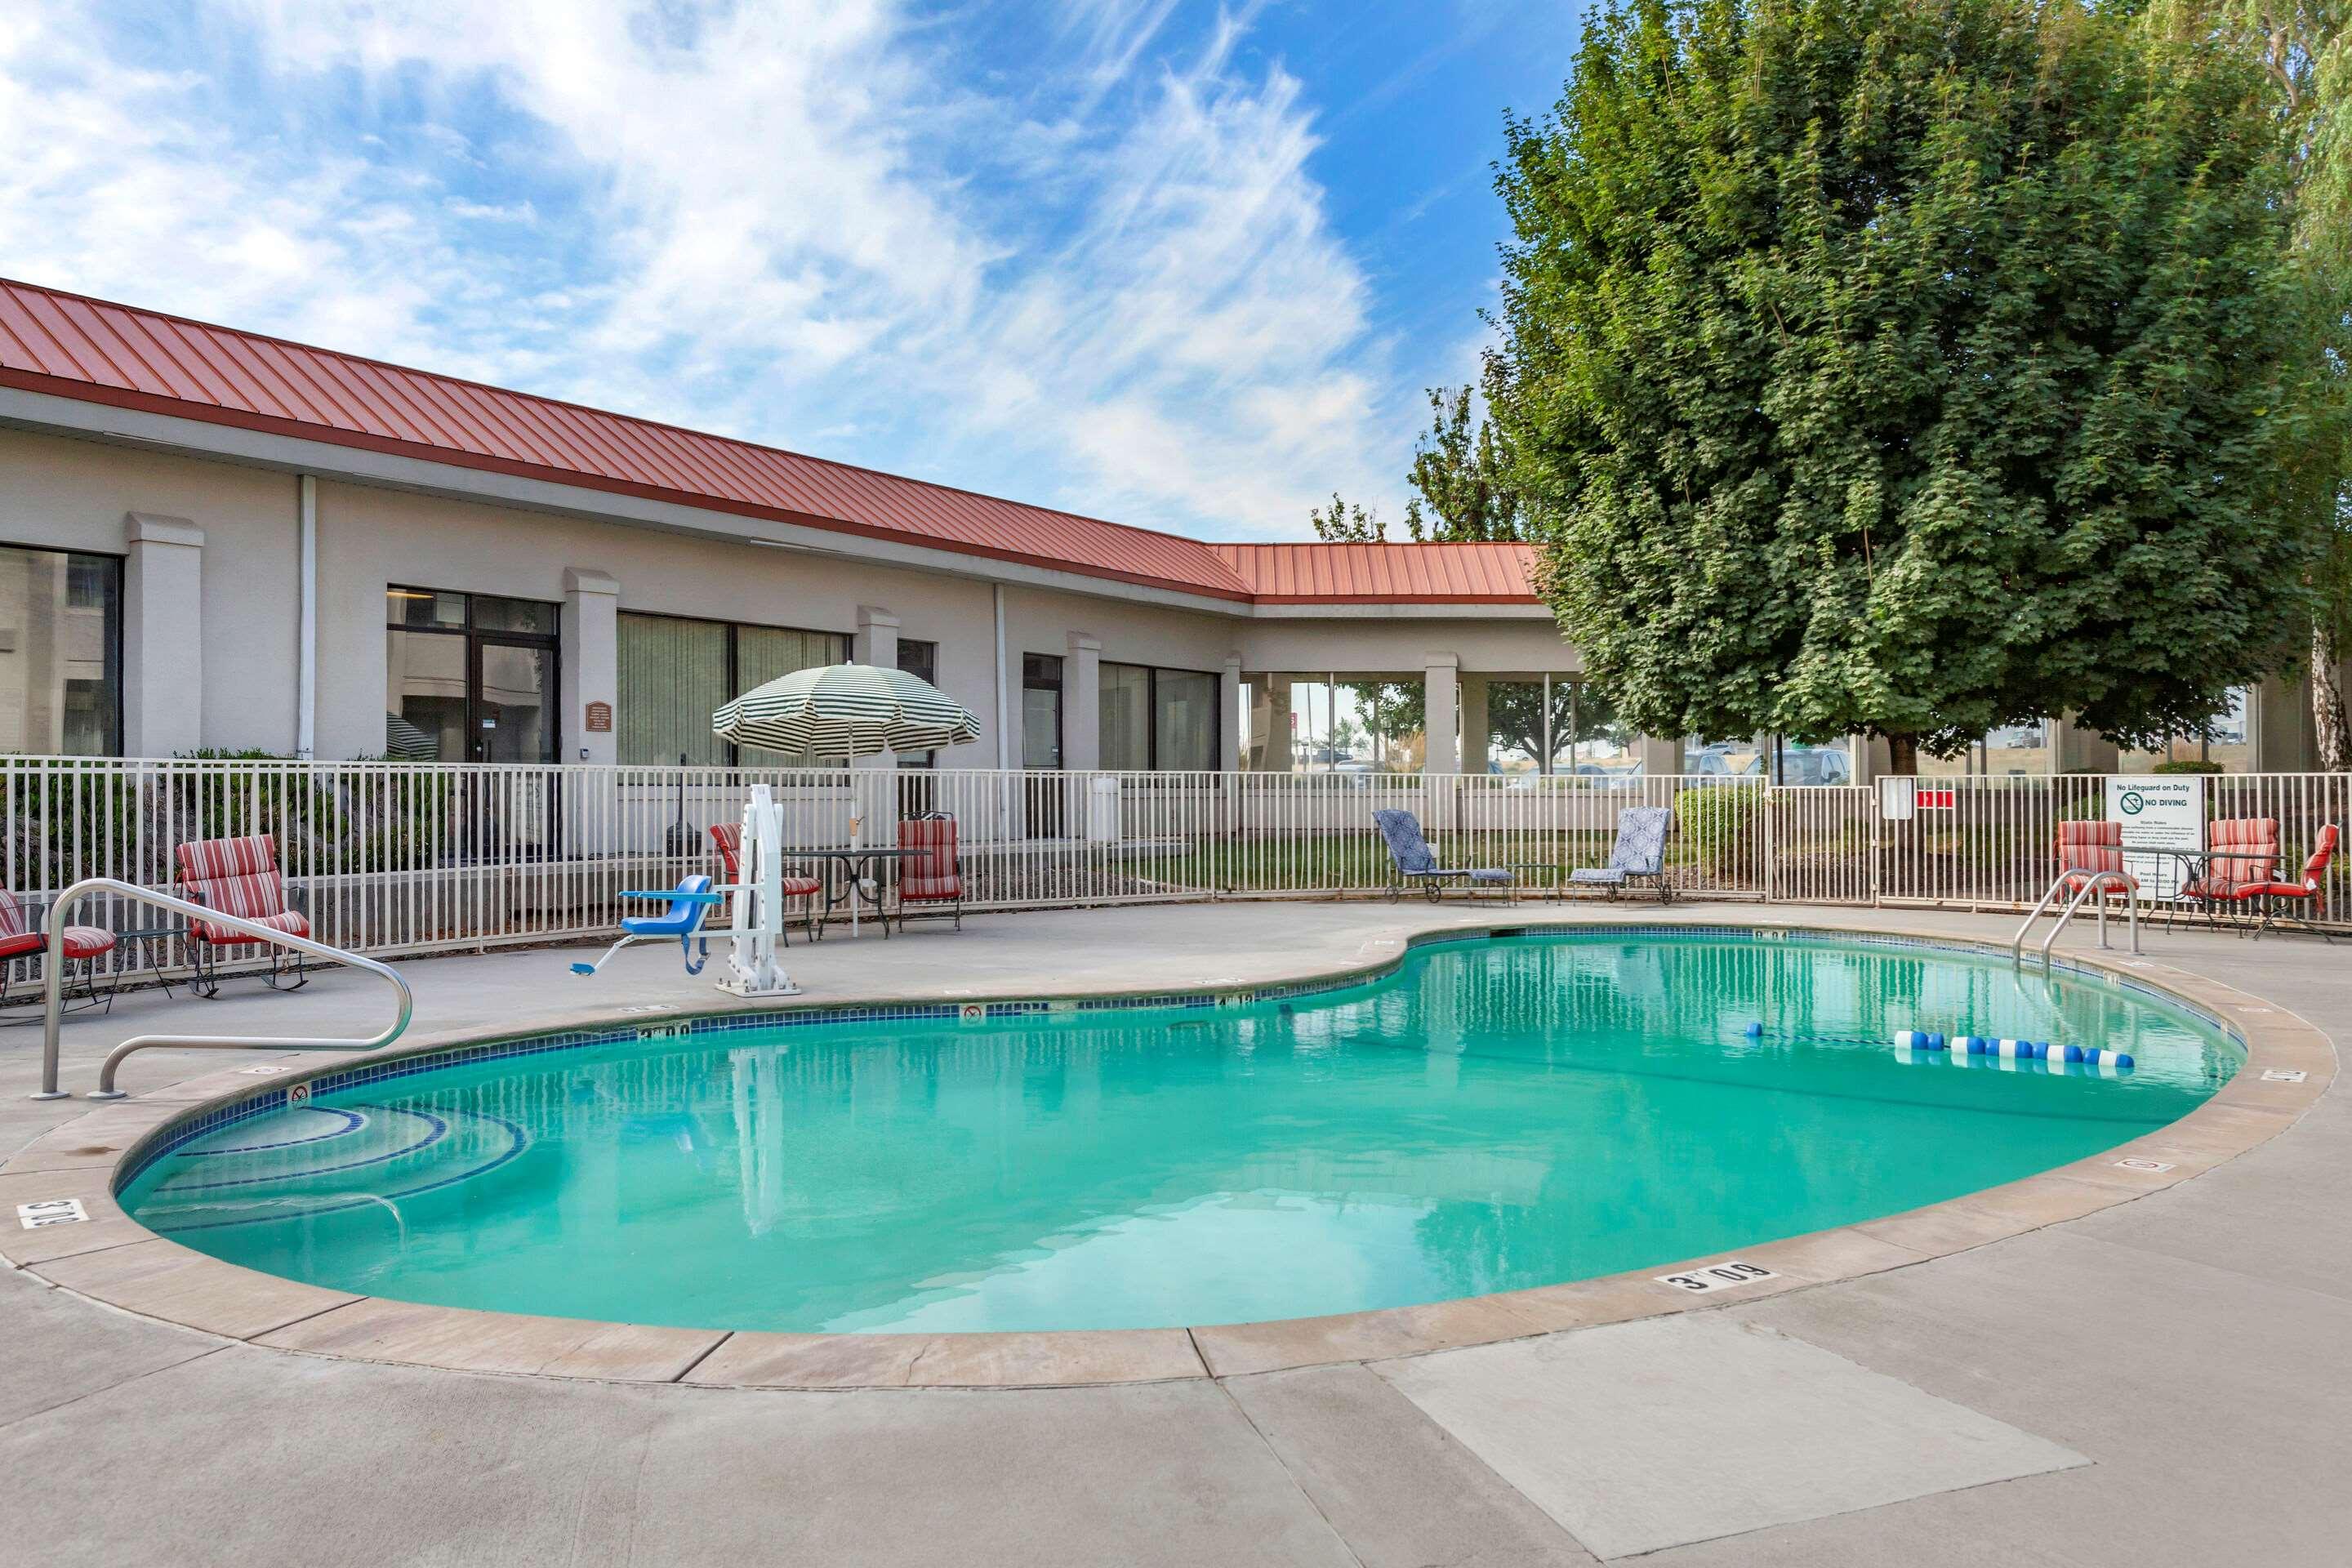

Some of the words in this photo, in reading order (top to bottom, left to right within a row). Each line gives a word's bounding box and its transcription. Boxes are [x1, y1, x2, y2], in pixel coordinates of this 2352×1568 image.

[2128, 784, 2160, 792] Lifeguard
[27, 1200, 72, 1209] 3
[1667, 1276, 1708, 1290] 3
